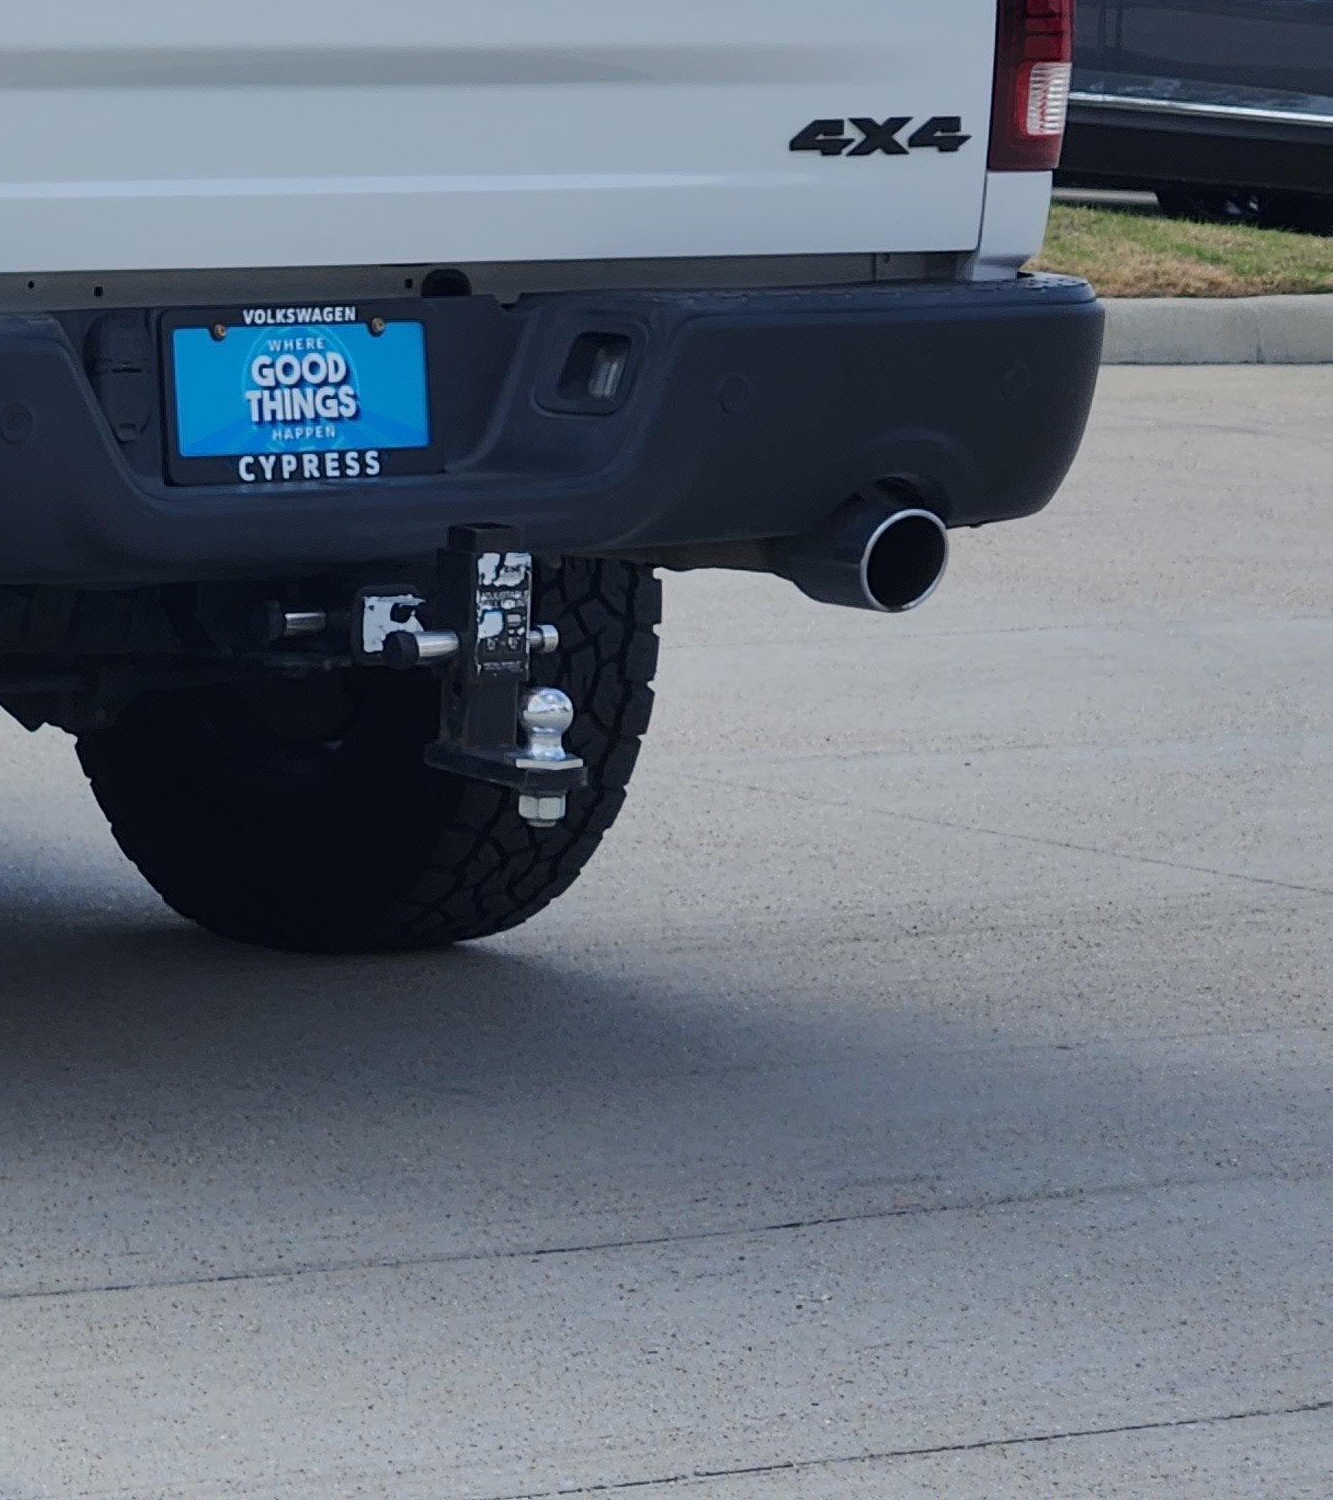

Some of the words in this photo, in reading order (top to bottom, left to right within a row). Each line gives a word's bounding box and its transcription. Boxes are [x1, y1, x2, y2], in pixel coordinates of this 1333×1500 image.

[243, 306, 356, 325] VOLKSWAGEN
[268, 338, 325, 351] WHERE
[251, 352, 347, 387] GOOD
[245, 385, 357, 422] THINGS
[272, 426, 336, 441] HAPPEN
[238, 451, 381, 482] CYPRESS
